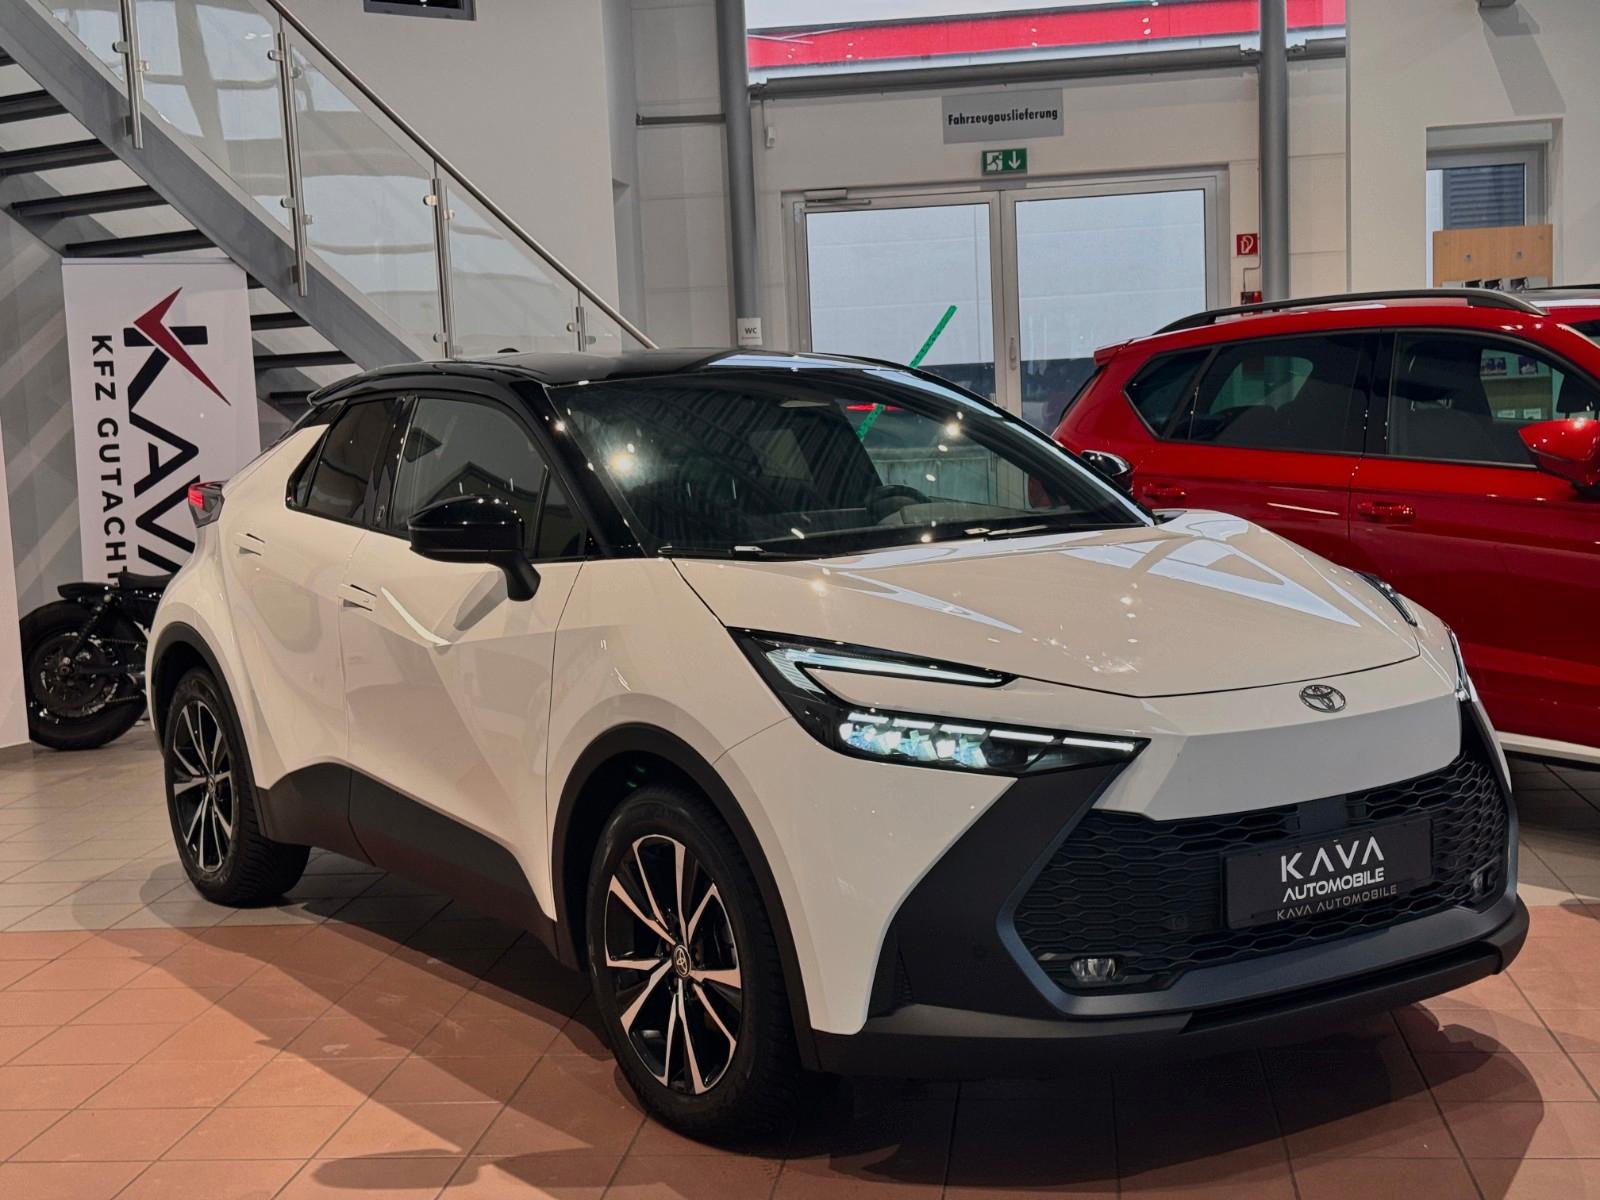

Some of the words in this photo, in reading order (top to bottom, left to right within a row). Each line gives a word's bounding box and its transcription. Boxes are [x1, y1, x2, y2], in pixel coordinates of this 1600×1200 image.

[948, 107, 1058, 126] Fahrzeugauslieferung
[744, 327, 757, 335] WC
[91, 335, 116, 401] KFZ
[1280, 836, 1385, 883] KAVA
[1276, 904, 1313, 921] KAVA
[1316, 884, 1398, 913] AUTOMOBILE
[1282, 867, 1385, 903] AUTOMOBILE
